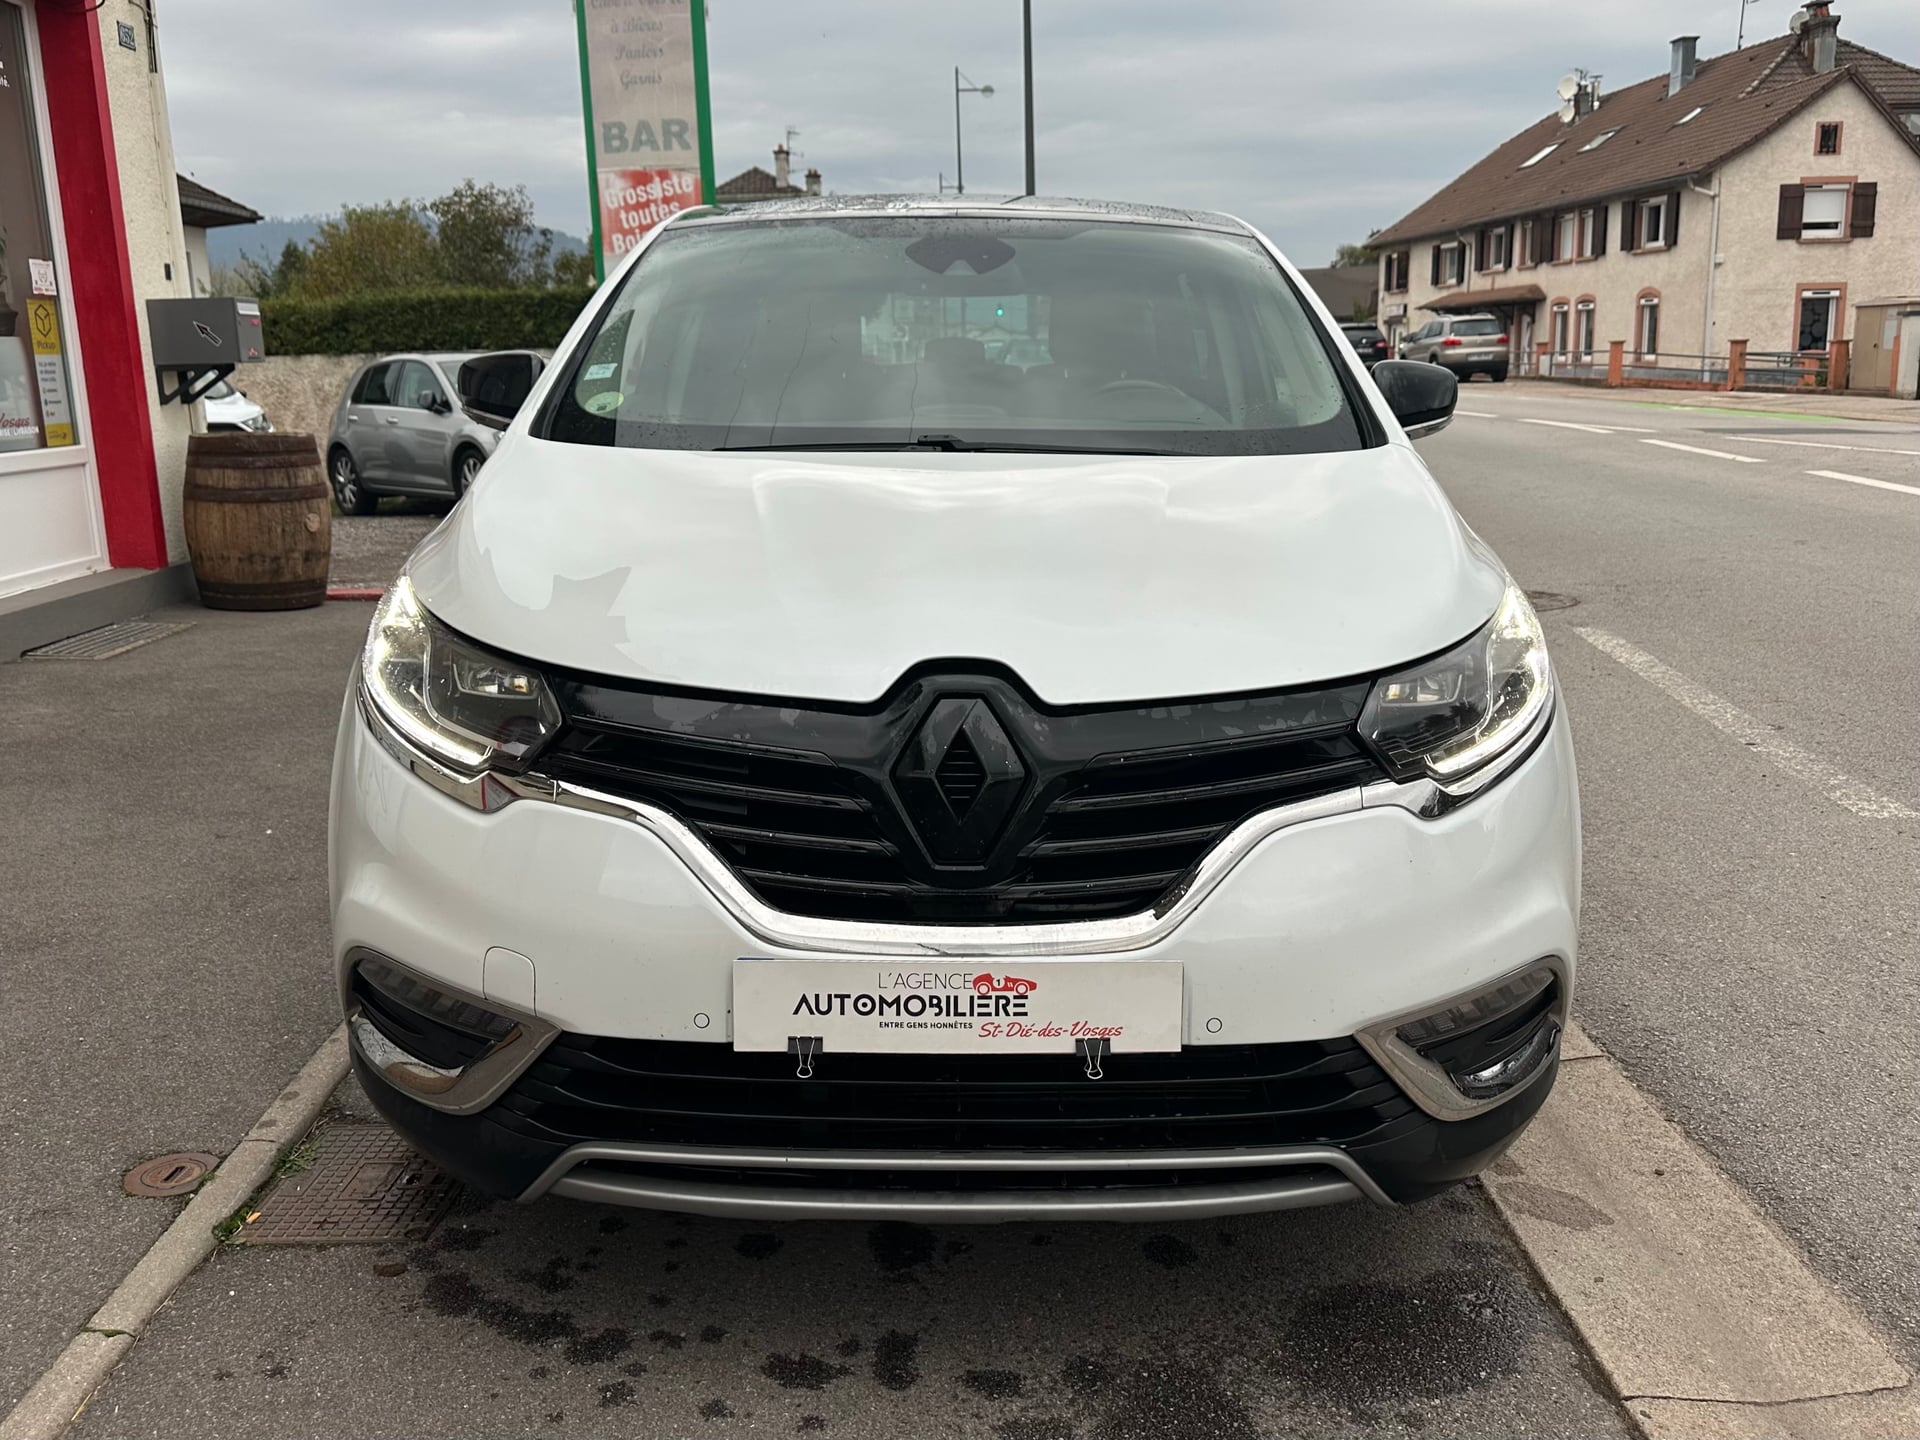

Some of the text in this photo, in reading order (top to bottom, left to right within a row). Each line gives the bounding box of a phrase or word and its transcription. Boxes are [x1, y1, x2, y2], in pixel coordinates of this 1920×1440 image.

[620, 68, 662, 91] Garnis
[602, 118, 692, 154] BAR
[604, 174, 695, 210] Grossiste
[620, 201, 681, 230] toutes
[611, 228, 648, 255] Boi
[879, 1019, 973, 1030] ENTRE GENS HONNÊTES
[978, 1020, 1123, 1039] St-Dié-des-Vosges
